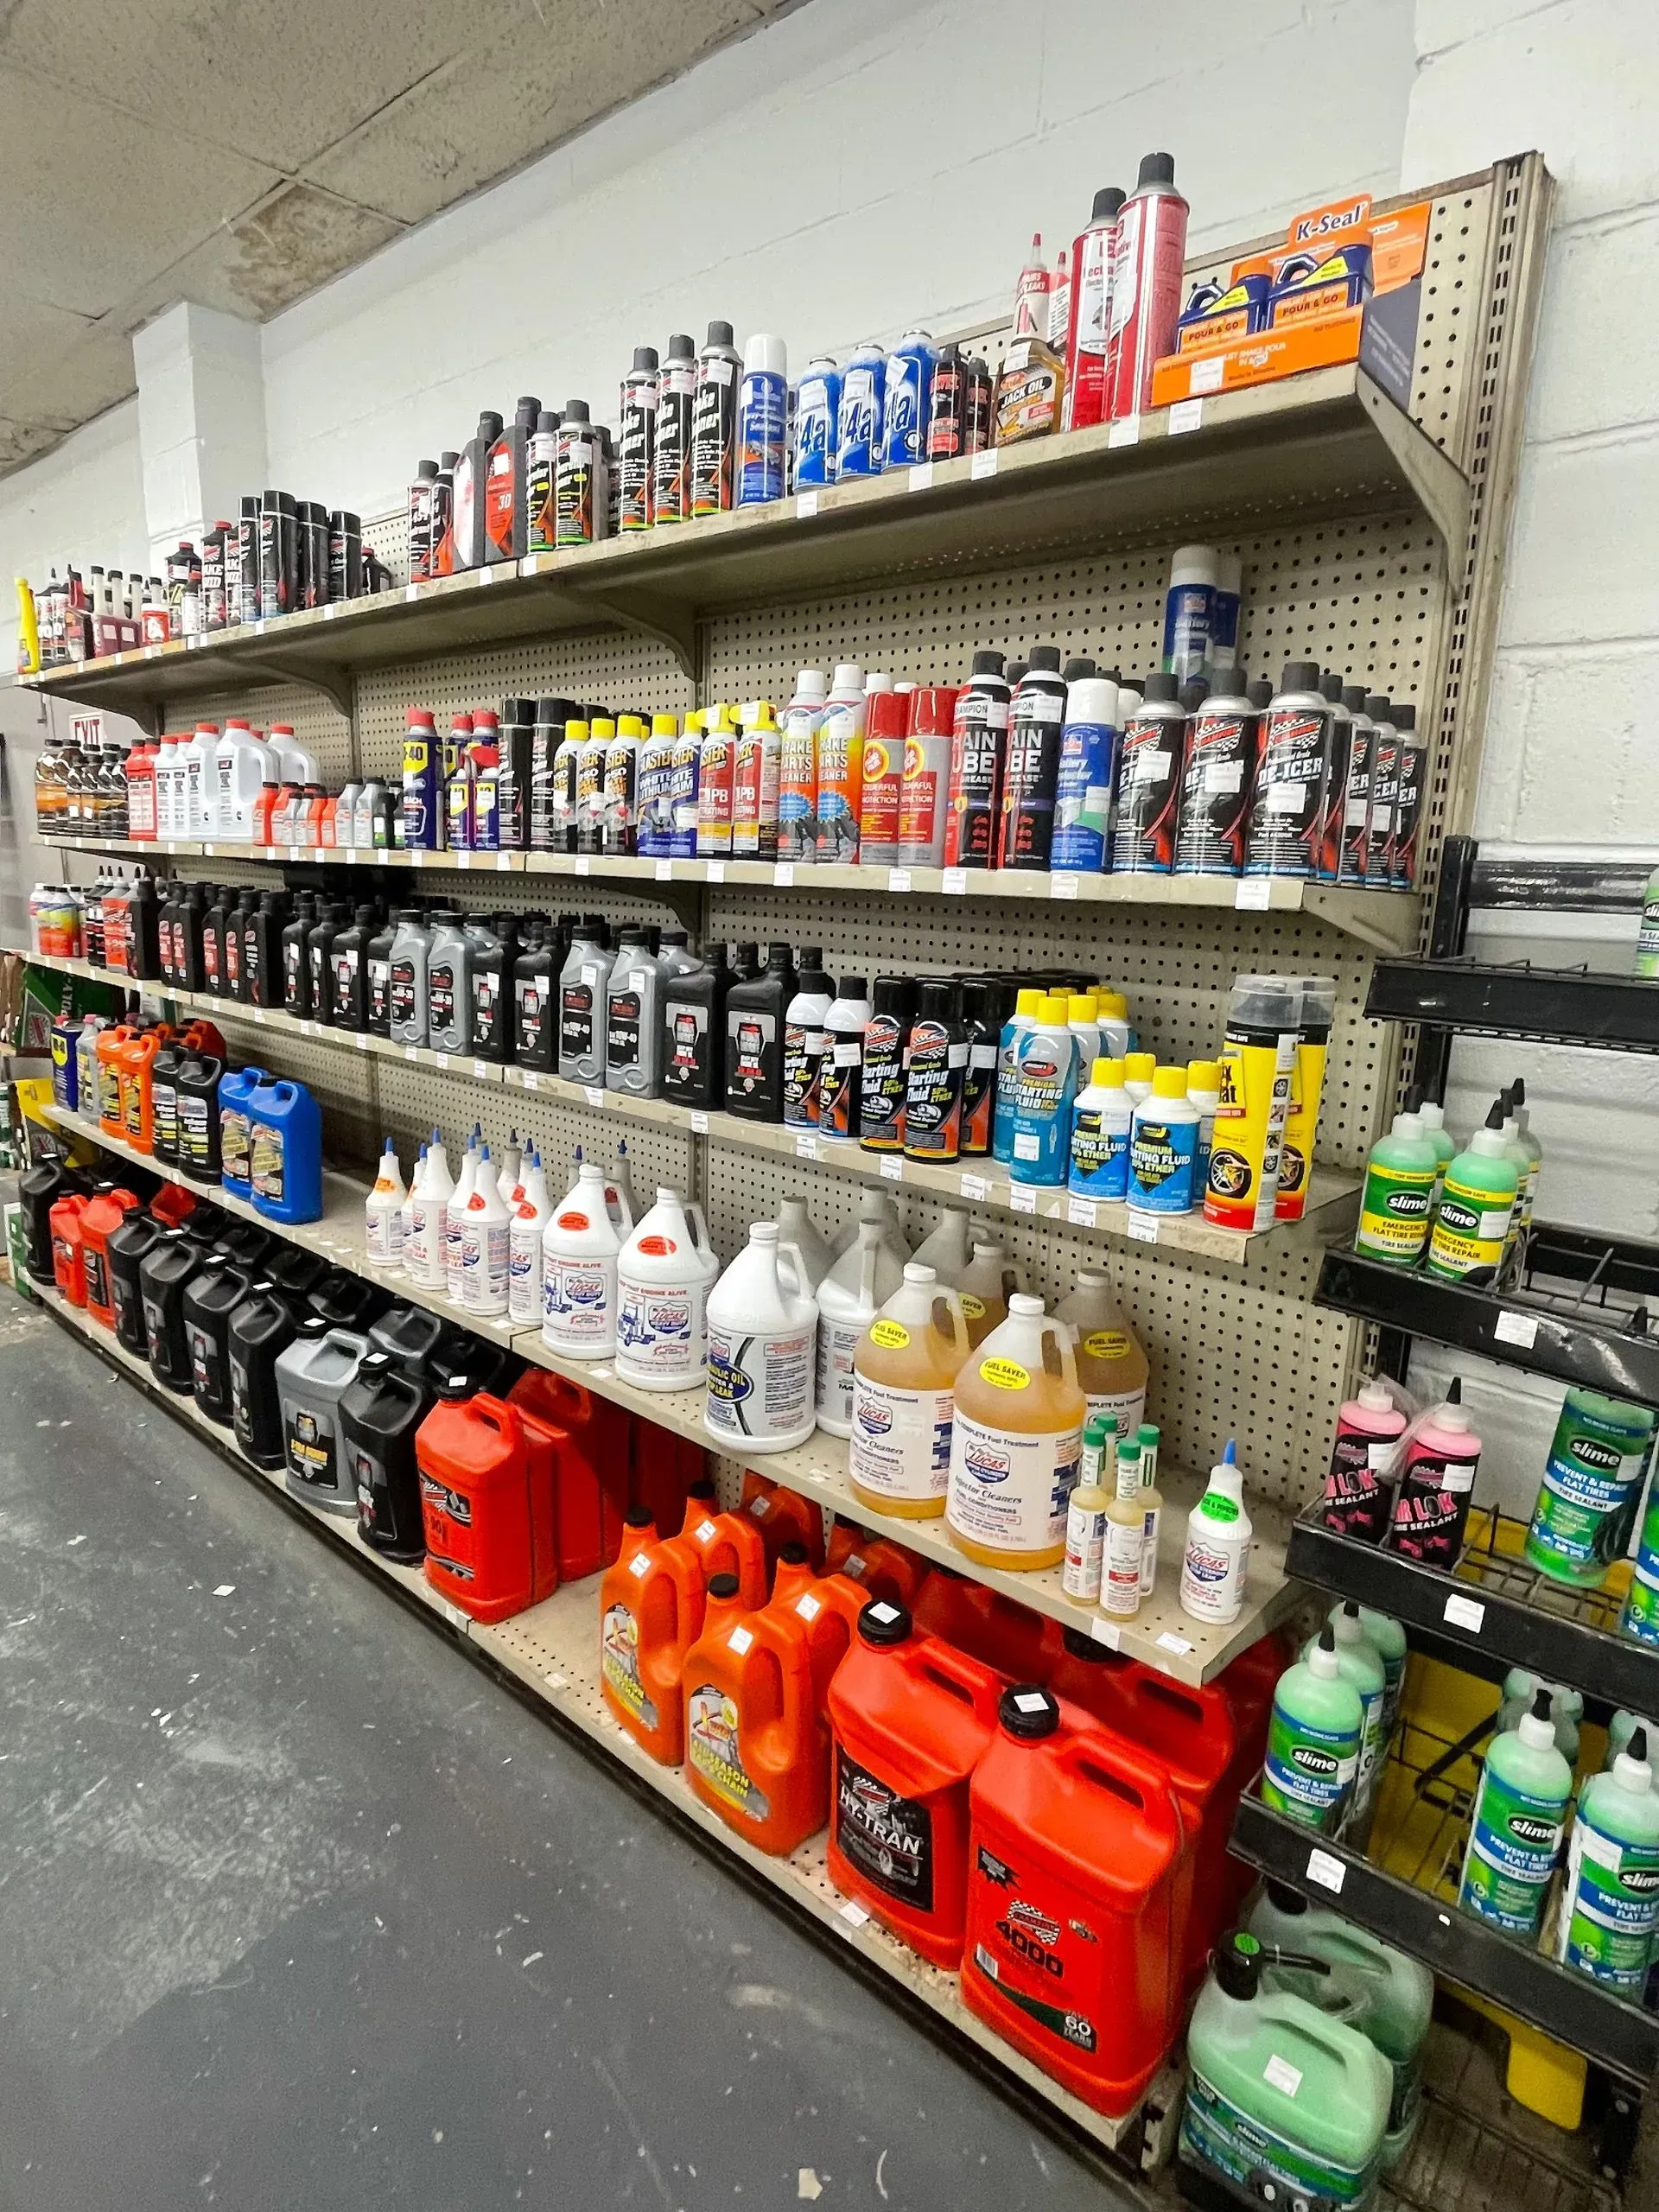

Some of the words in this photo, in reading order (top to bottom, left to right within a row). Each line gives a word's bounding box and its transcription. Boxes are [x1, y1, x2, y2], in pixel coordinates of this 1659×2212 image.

[1297, 205, 1361, 241] K-Seal
[1001, 385, 1027, 409] JACK
[1027, 378, 1046, 394] OIL
[498, 493, 512, 511] 30
[1257, 757, 1324, 787] DE-ICER
[1098, 1141, 1127, 1153] FLUID
[1161, 1154, 1191, 1166] FLUID
[1388, 1192, 1427, 1211] slime
[1440, 1205, 1478, 1227] slime
[1452, 1243, 1481, 1260] REPAIR
[731, 1372, 745, 1387] OIL
[1001, 1364, 1027, 1380] SAVER
[859, 1404, 890, 1422] LUCAS
[868, 1440, 905, 1455] Cleaners
[1002, 1436, 1039, 1449] Treatment
[968, 1452, 1007, 1471] LUCAS
[1571, 1441, 1620, 1466] slime
[1553, 1460, 1589, 1485] PREVENT
[1589, 1478, 1599, 1487] &
[982, 1489, 1023, 1505] Cleaners
[1335, 1488, 1380, 1506] SEALANT
[1562, 1476, 1584, 1492] FLAT
[1585, 1486, 1611, 1499] TIRES
[1559, 1486, 1573, 1498] TIRE
[1573, 1493, 1609, 1510] SEALANT
[1410, 1513, 1459, 1531] SEALANT
[1294, 1751, 1337, 1771] slime
[840, 1783, 921, 1855] HY-TRAN
[1490, 1834, 1533, 1860] PREVENT
[1533, 1853, 1541, 1862] &
[1503, 1853, 1526, 1869] FLAT
[1621, 1872, 1659, 1888] slim
[1598, 1892, 1642, 1913] PREVENT
[995, 1919, 1065, 1979] 4000
[1065, 2015, 1091, 2037] 60
